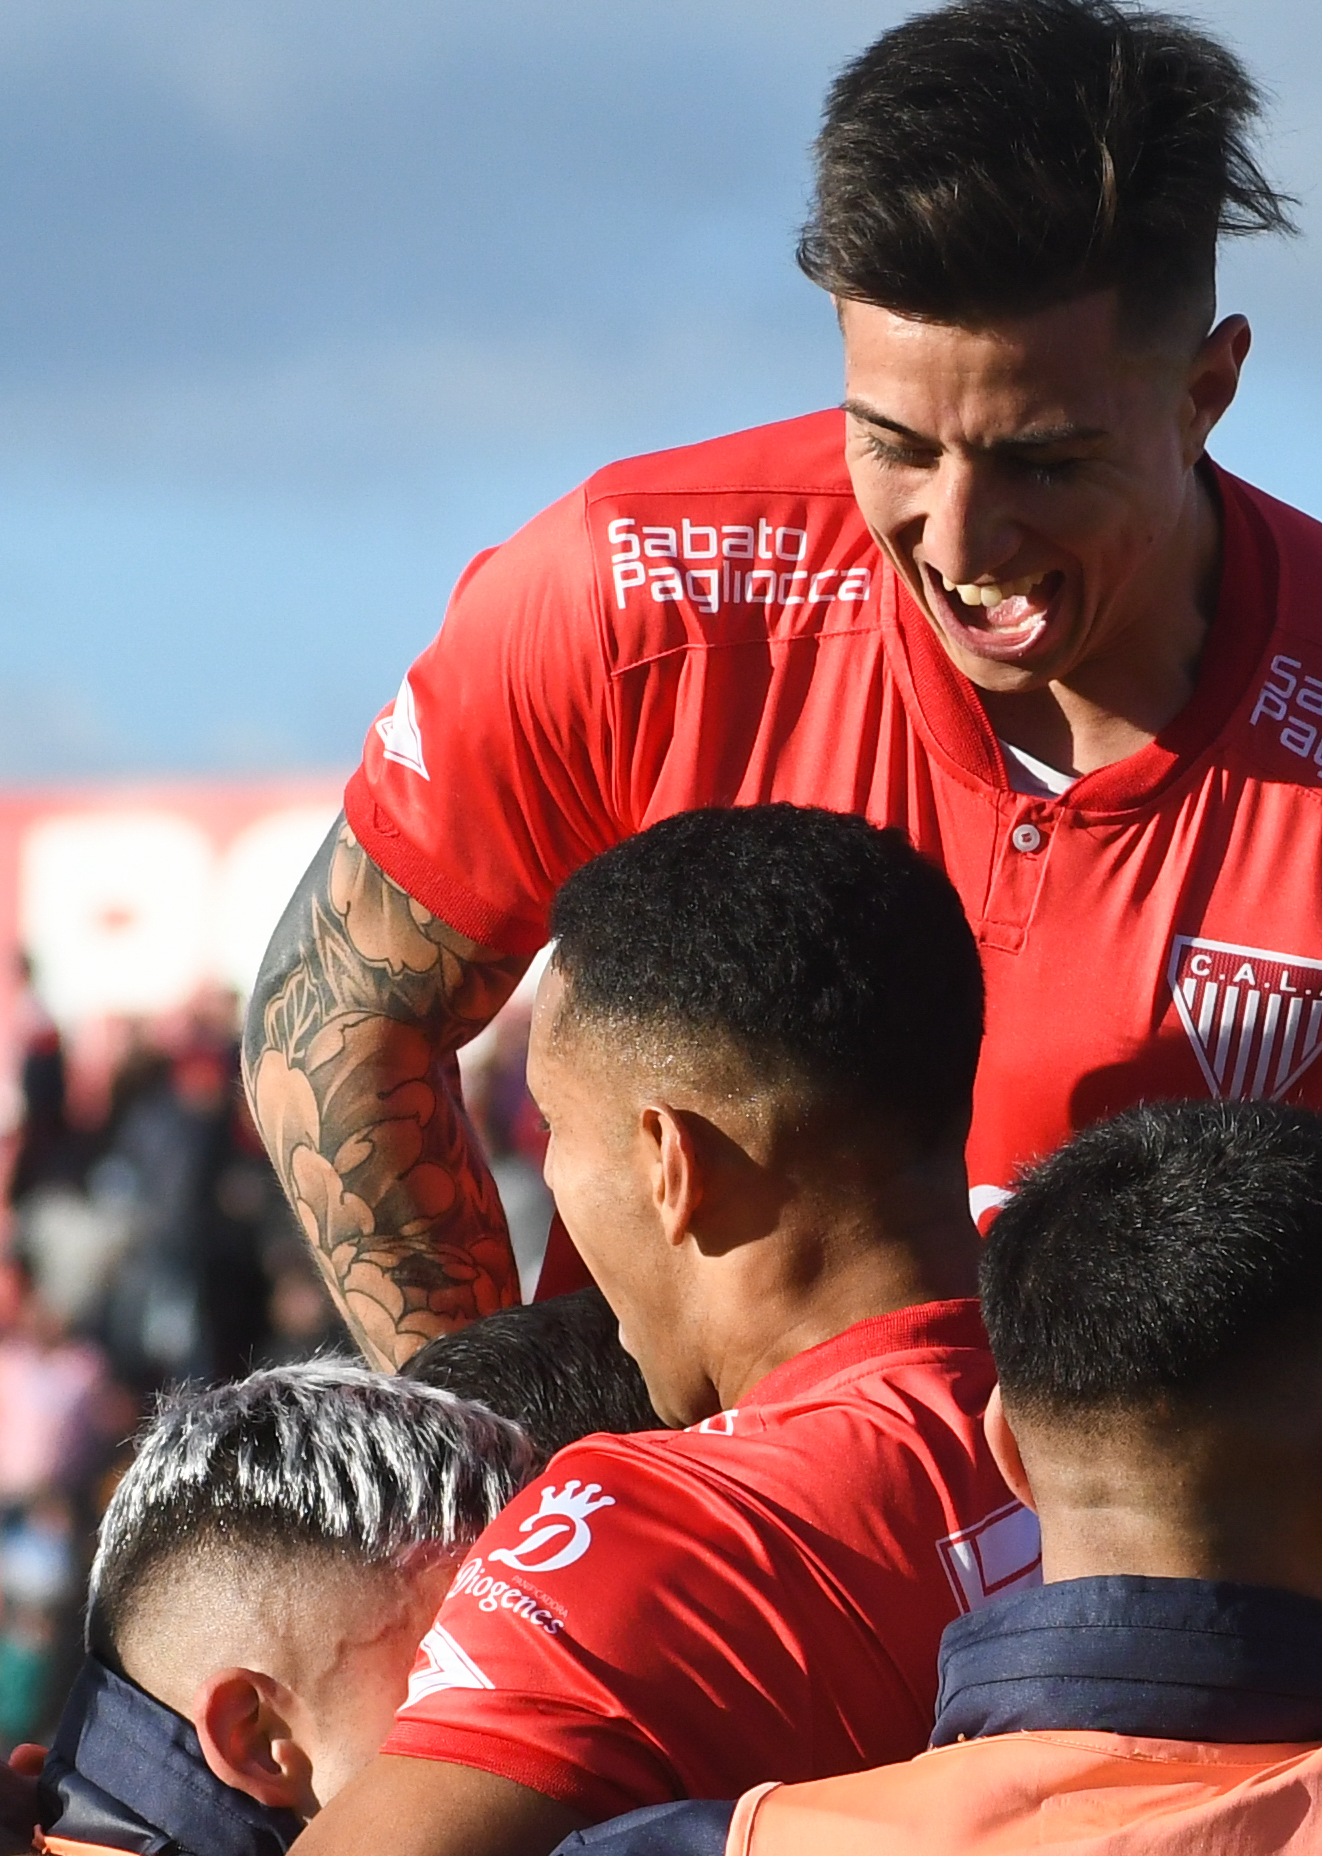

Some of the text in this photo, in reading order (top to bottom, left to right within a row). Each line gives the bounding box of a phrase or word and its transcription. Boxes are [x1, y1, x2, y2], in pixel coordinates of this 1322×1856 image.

[608, 518, 807, 563] Sabato
[612, 560, 871, 613] Pagliocca
[446, 1557, 564, 1635] Diogenes
[511, 1574, 569, 1619] PANIFICADORA
